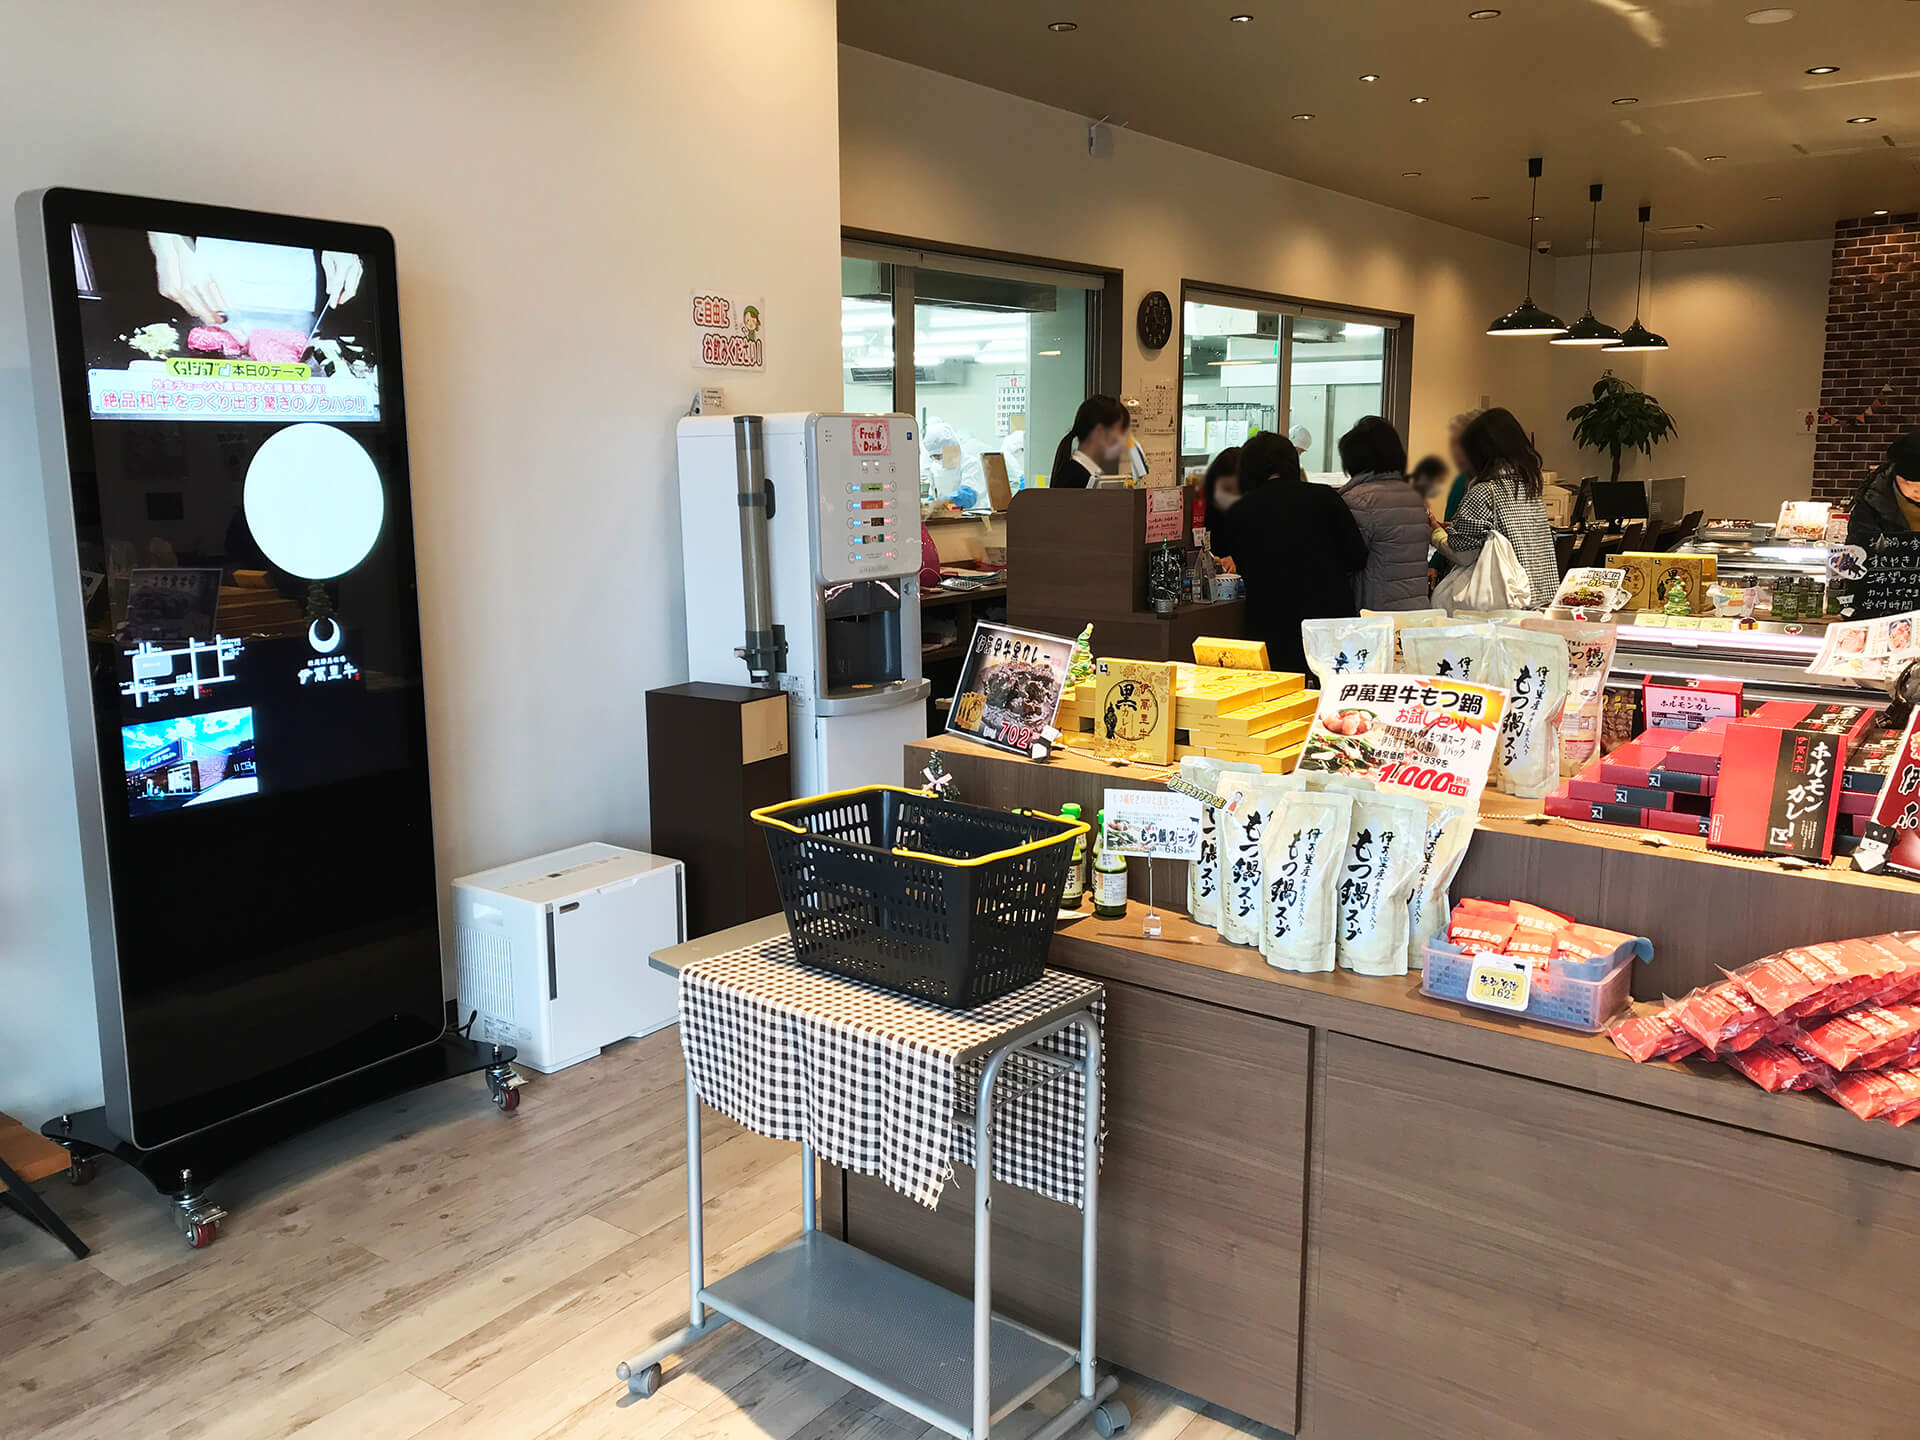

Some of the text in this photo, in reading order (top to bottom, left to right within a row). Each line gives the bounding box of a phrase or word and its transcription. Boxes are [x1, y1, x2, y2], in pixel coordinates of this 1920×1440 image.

[232, 365, 306, 378] 本日のテーマ
[859, 427, 875, 440] Free
[863, 441, 882, 452] Drink
[1339, 684, 1484, 716] 伊萬里牛もつ鍋
[1660, 700, 1721, 712] ホルモンカレー
[1395, 708, 1473, 734] お試しセット
[1270, 829, 1302, 939] もつ鍋スープ
[1340, 828, 1374, 942] もつ鍋スープ
[1491, 987, 1511, 999] 162
